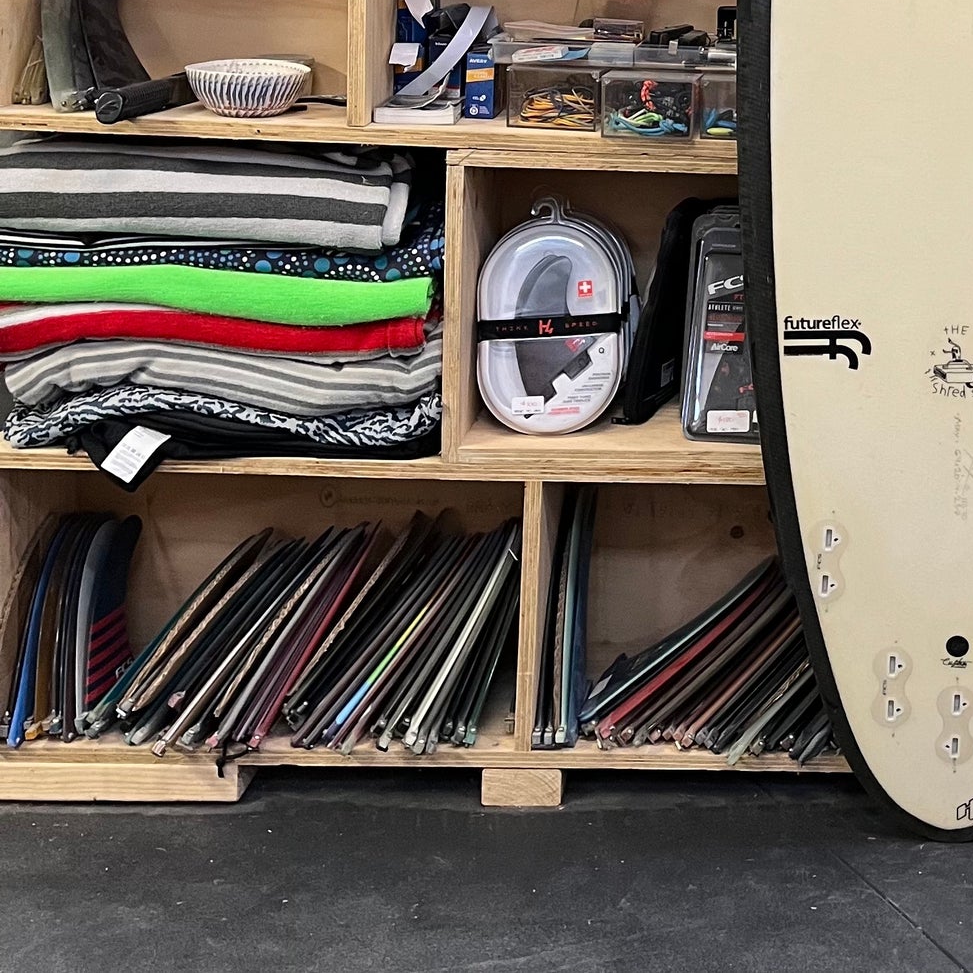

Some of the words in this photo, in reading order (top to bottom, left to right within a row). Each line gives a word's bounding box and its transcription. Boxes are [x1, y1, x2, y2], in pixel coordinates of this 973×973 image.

[708, 274, 744, 295] FC
[783, 315, 861, 330] futureflex
[711, 343, 739, 352] AirCore
